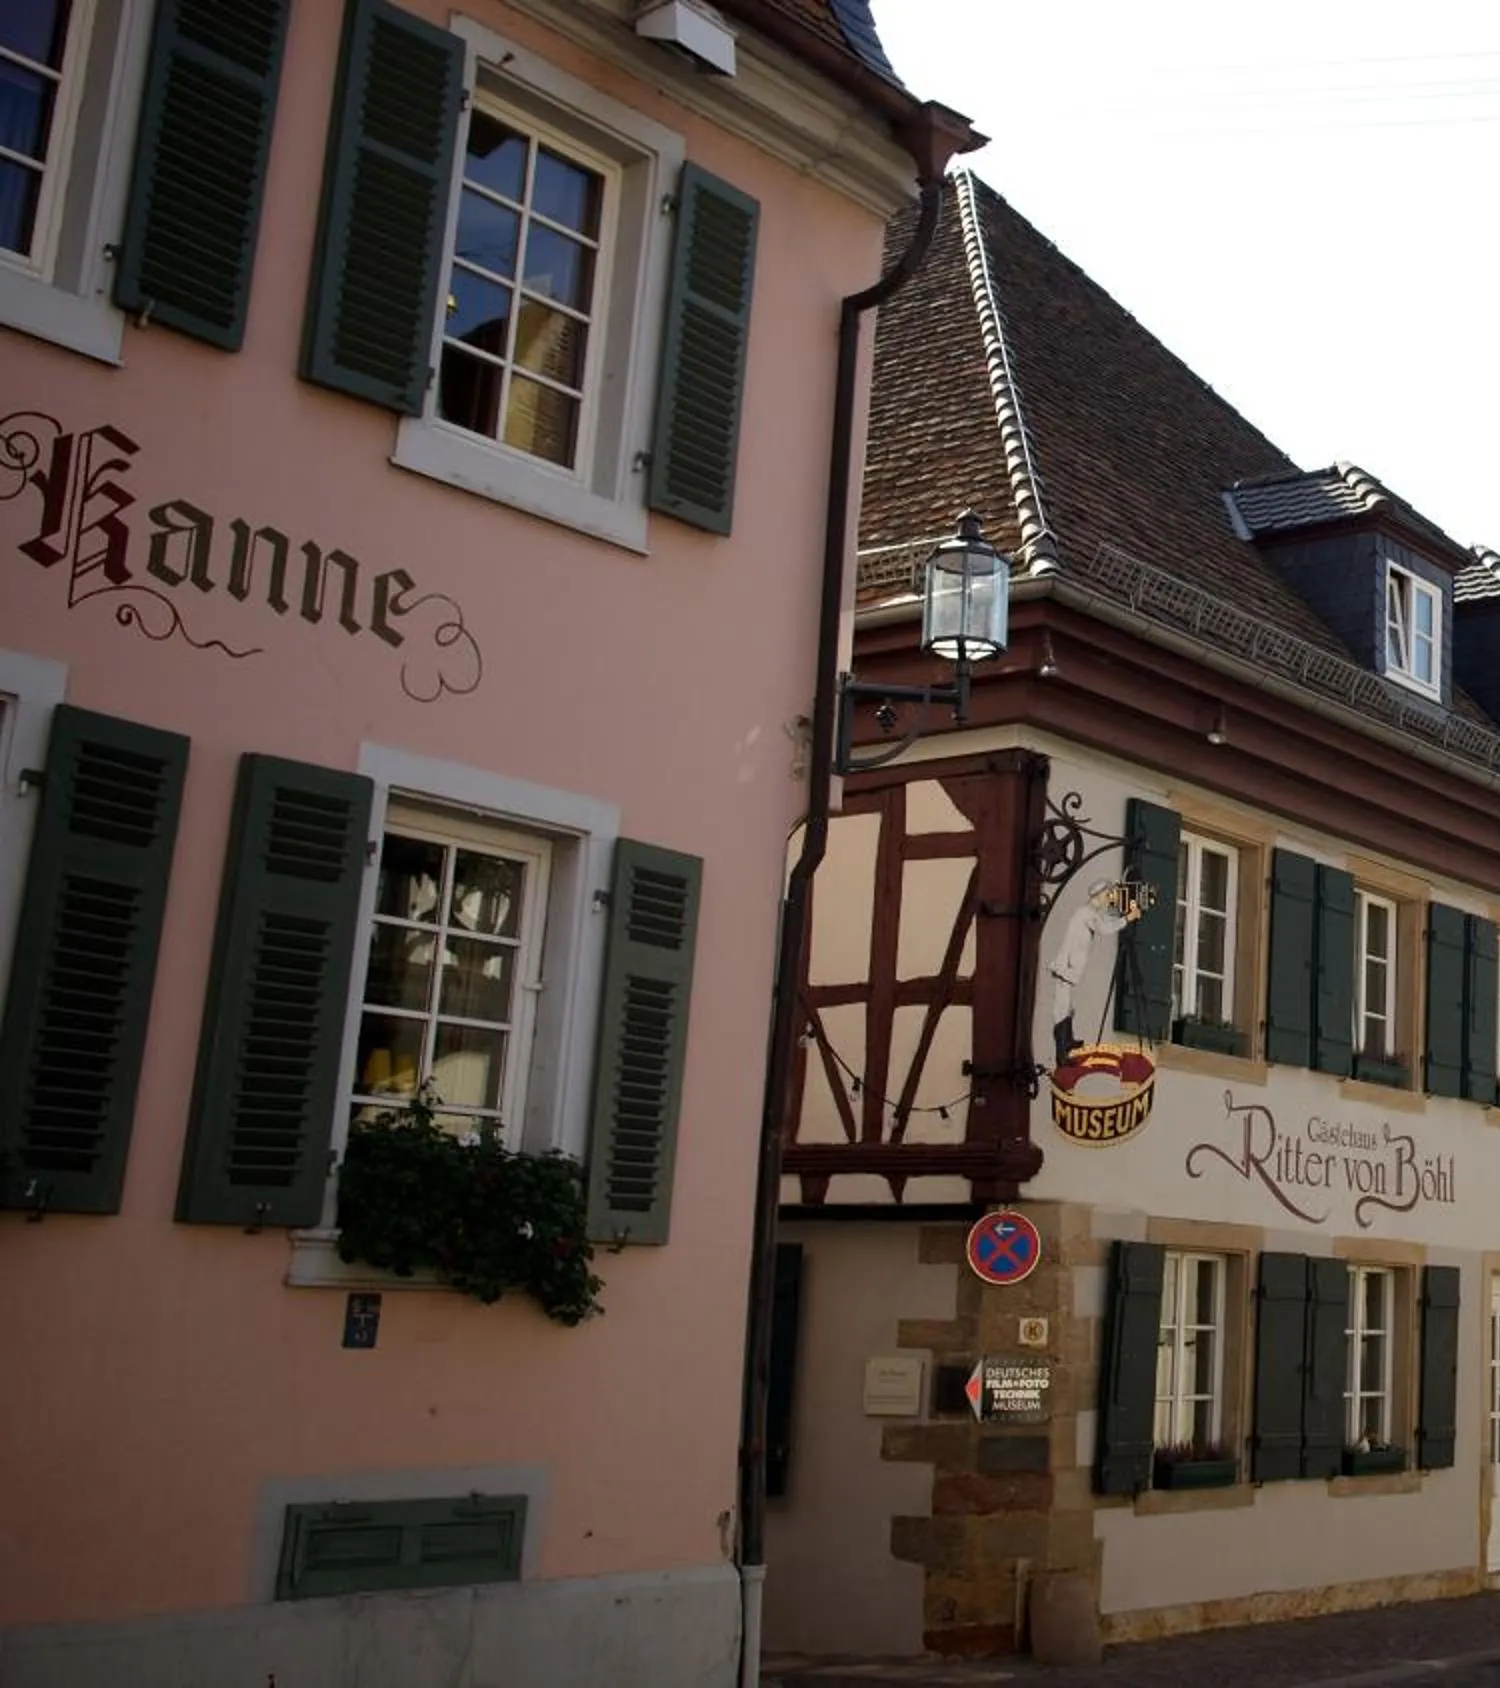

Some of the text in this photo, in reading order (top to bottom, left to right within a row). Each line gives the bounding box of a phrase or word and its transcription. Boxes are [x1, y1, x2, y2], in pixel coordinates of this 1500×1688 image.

[0, 411, 482, 702] Kanne
[1054, 1090, 1150, 1139] MUSEUM
[1186, 1089, 1456, 1229] Ritter von Böhl
[985, 1367, 1050, 1379] DEUTSCHES
[991, 1400, 1041, 1411] MUSEUM
